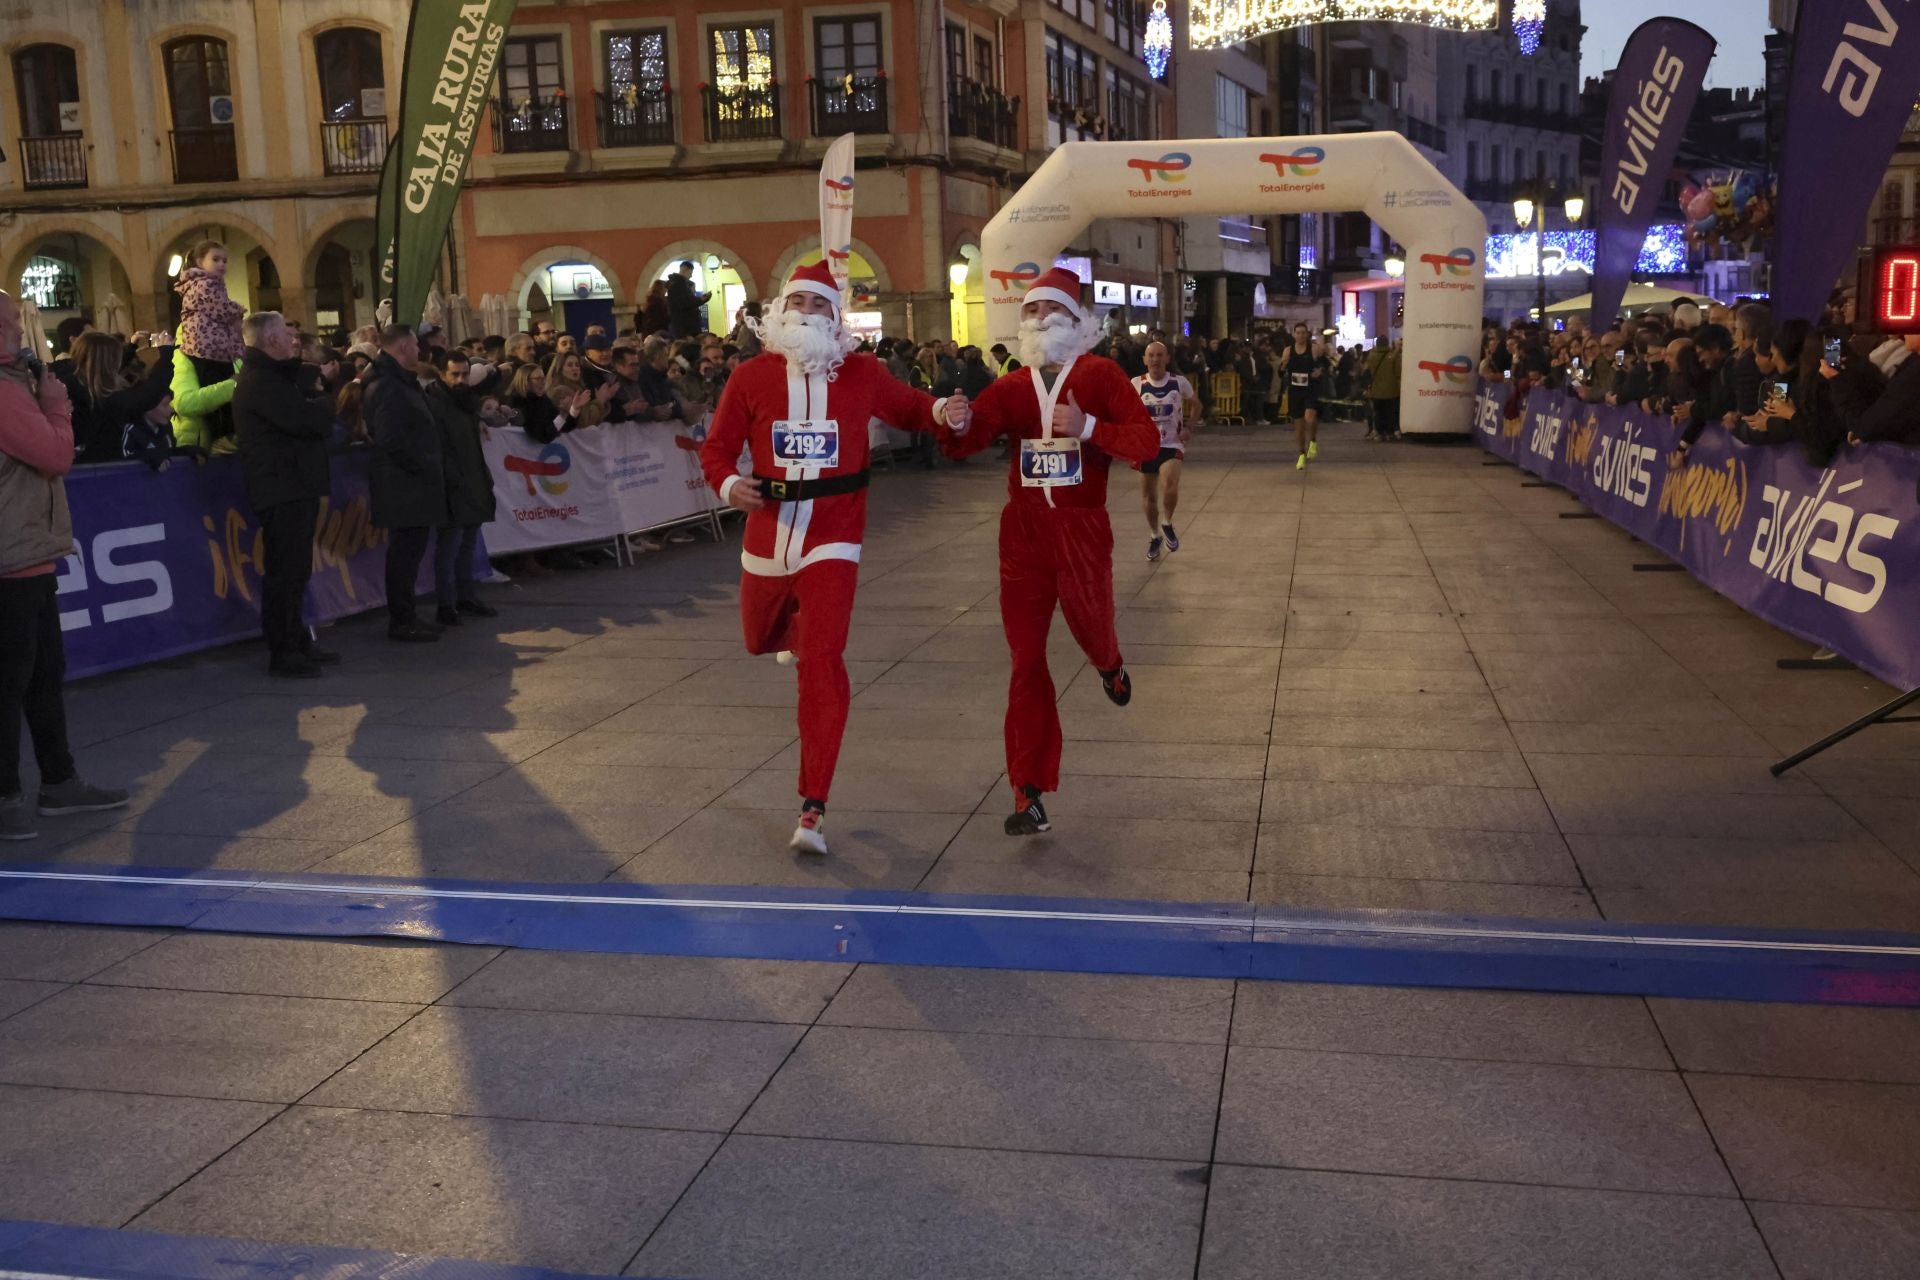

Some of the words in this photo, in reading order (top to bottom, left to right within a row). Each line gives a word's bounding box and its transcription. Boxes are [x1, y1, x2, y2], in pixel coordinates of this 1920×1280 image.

[404, 120, 451, 215] CAJA
[431, 0, 491, 114] RURA
[442, 149, 465, 187] DE
[454, 22, 505, 150] ASTURIAS
[1612, 45, 1685, 215] avilés
[1127, 187, 1193, 198] TotalEnergies
[1258, 182, 1326, 194] TotalEnergies
[1420, 281, 1475, 291] TotalEnergies
[992, 295, 1025, 305] TotalEne
[783, 434, 827, 455] 2192
[1031, 453, 1068, 474] 2191
[1593, 420, 1658, 508] avilés
[512, 503, 579, 523] TotalEnergies
[1748, 467, 1900, 614] avilés
